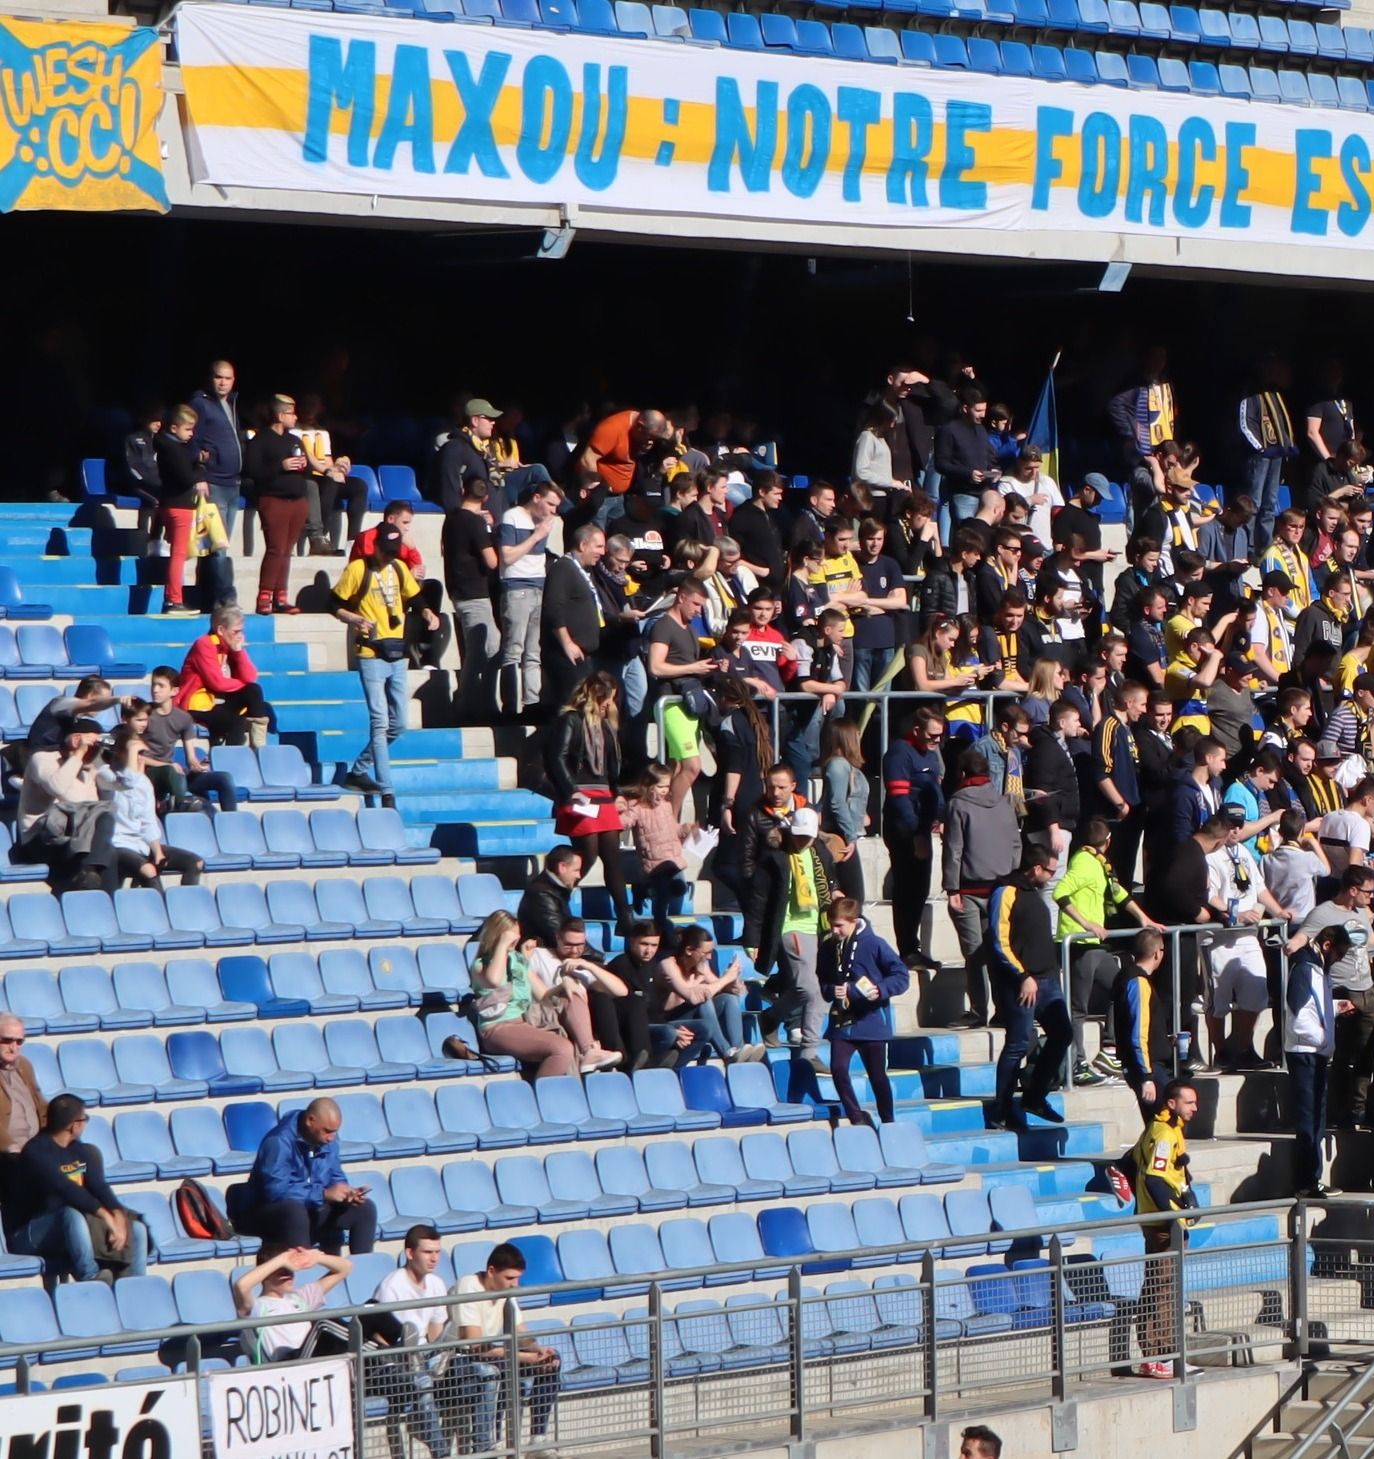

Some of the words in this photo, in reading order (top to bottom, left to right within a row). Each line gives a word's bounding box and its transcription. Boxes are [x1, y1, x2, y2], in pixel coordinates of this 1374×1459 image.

[2, 45, 123, 126] WESH
[302, 34, 627, 191] MAXOU
[707, 76, 992, 210] NOTRE
[1031, 106, 1256, 229] FORCE
